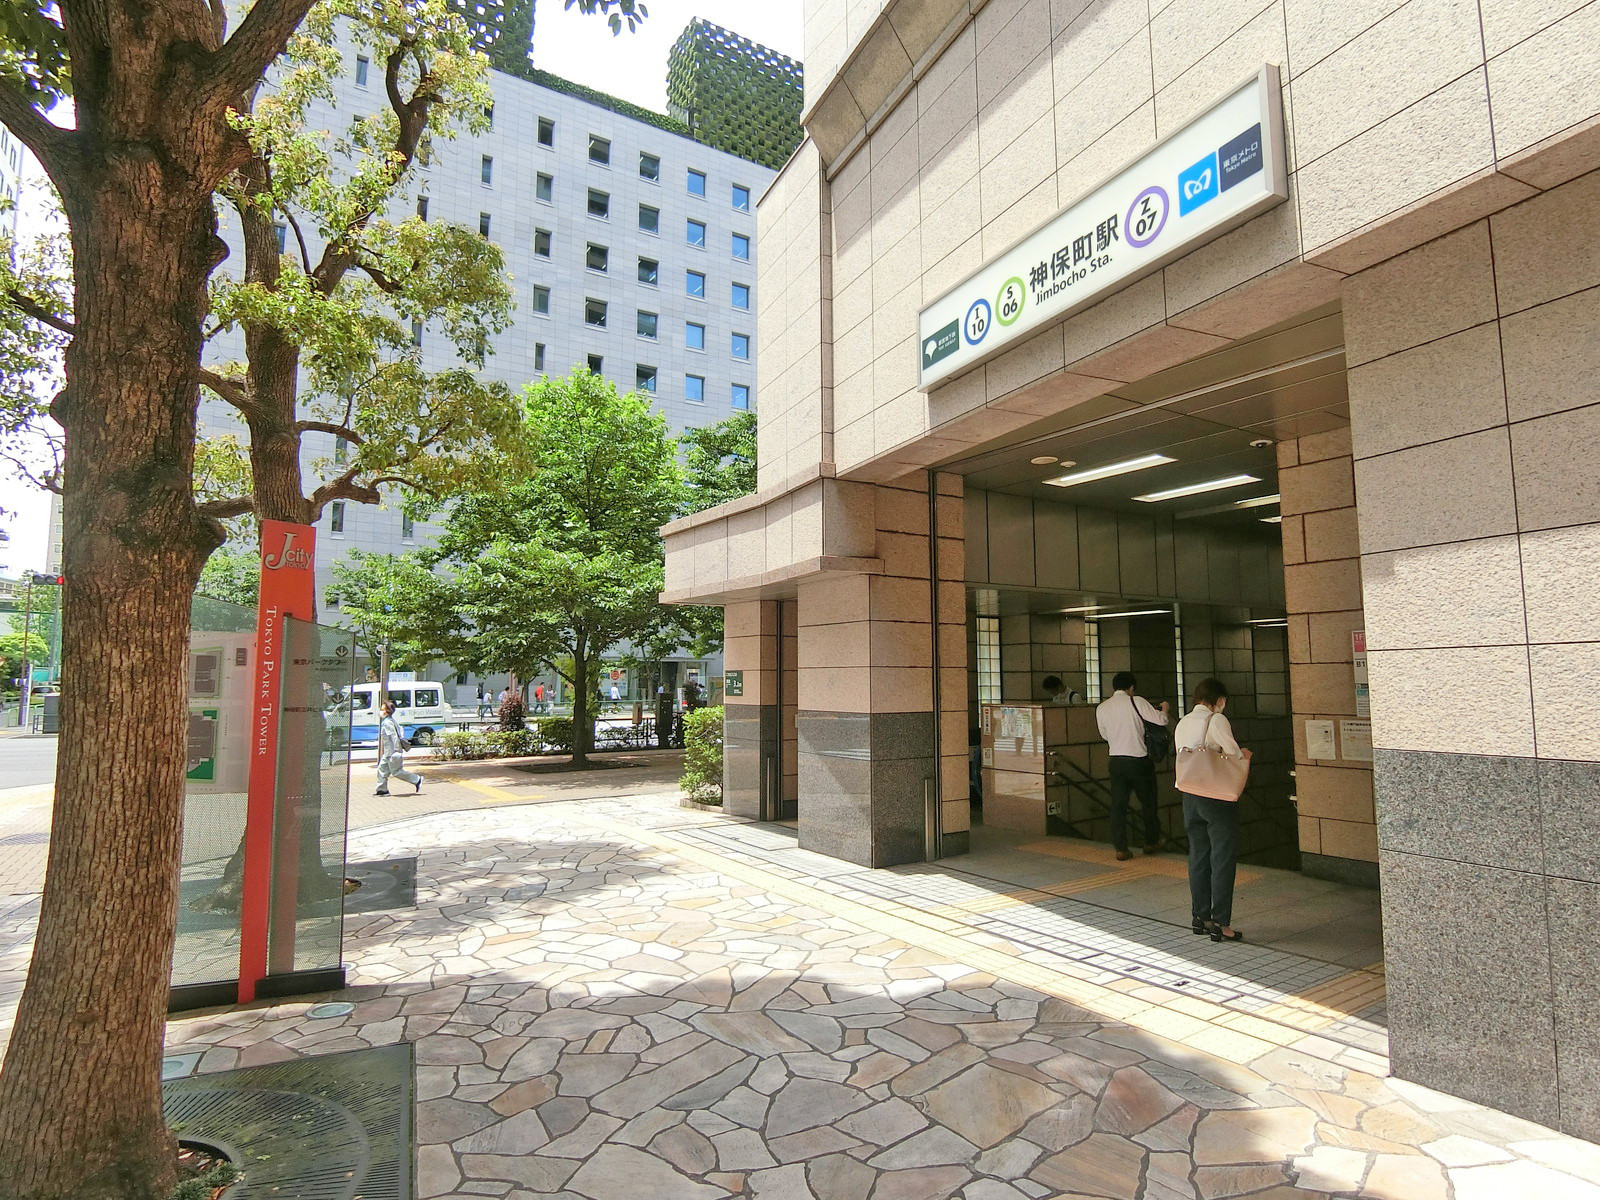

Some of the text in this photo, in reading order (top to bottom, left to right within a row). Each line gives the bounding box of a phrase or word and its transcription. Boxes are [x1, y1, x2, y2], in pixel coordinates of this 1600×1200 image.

[1223, 141, 1258, 168] 東京メトロ
[1225, 152, 1256, 173] Tokyo Metro
[1141, 196, 1151, 216] Z
[1136, 210, 1157, 236] 07
[1029, 213, 1119, 293] 神保町駅
[1036, 254, 1113, 305] Jimbocho Sta.
[1007, 286, 1013, 299] S
[1003, 298, 1018, 317] 06
[972, 318, 985, 336] 10
[259, 606, 277, 755] TOKYO PARK TOWER
